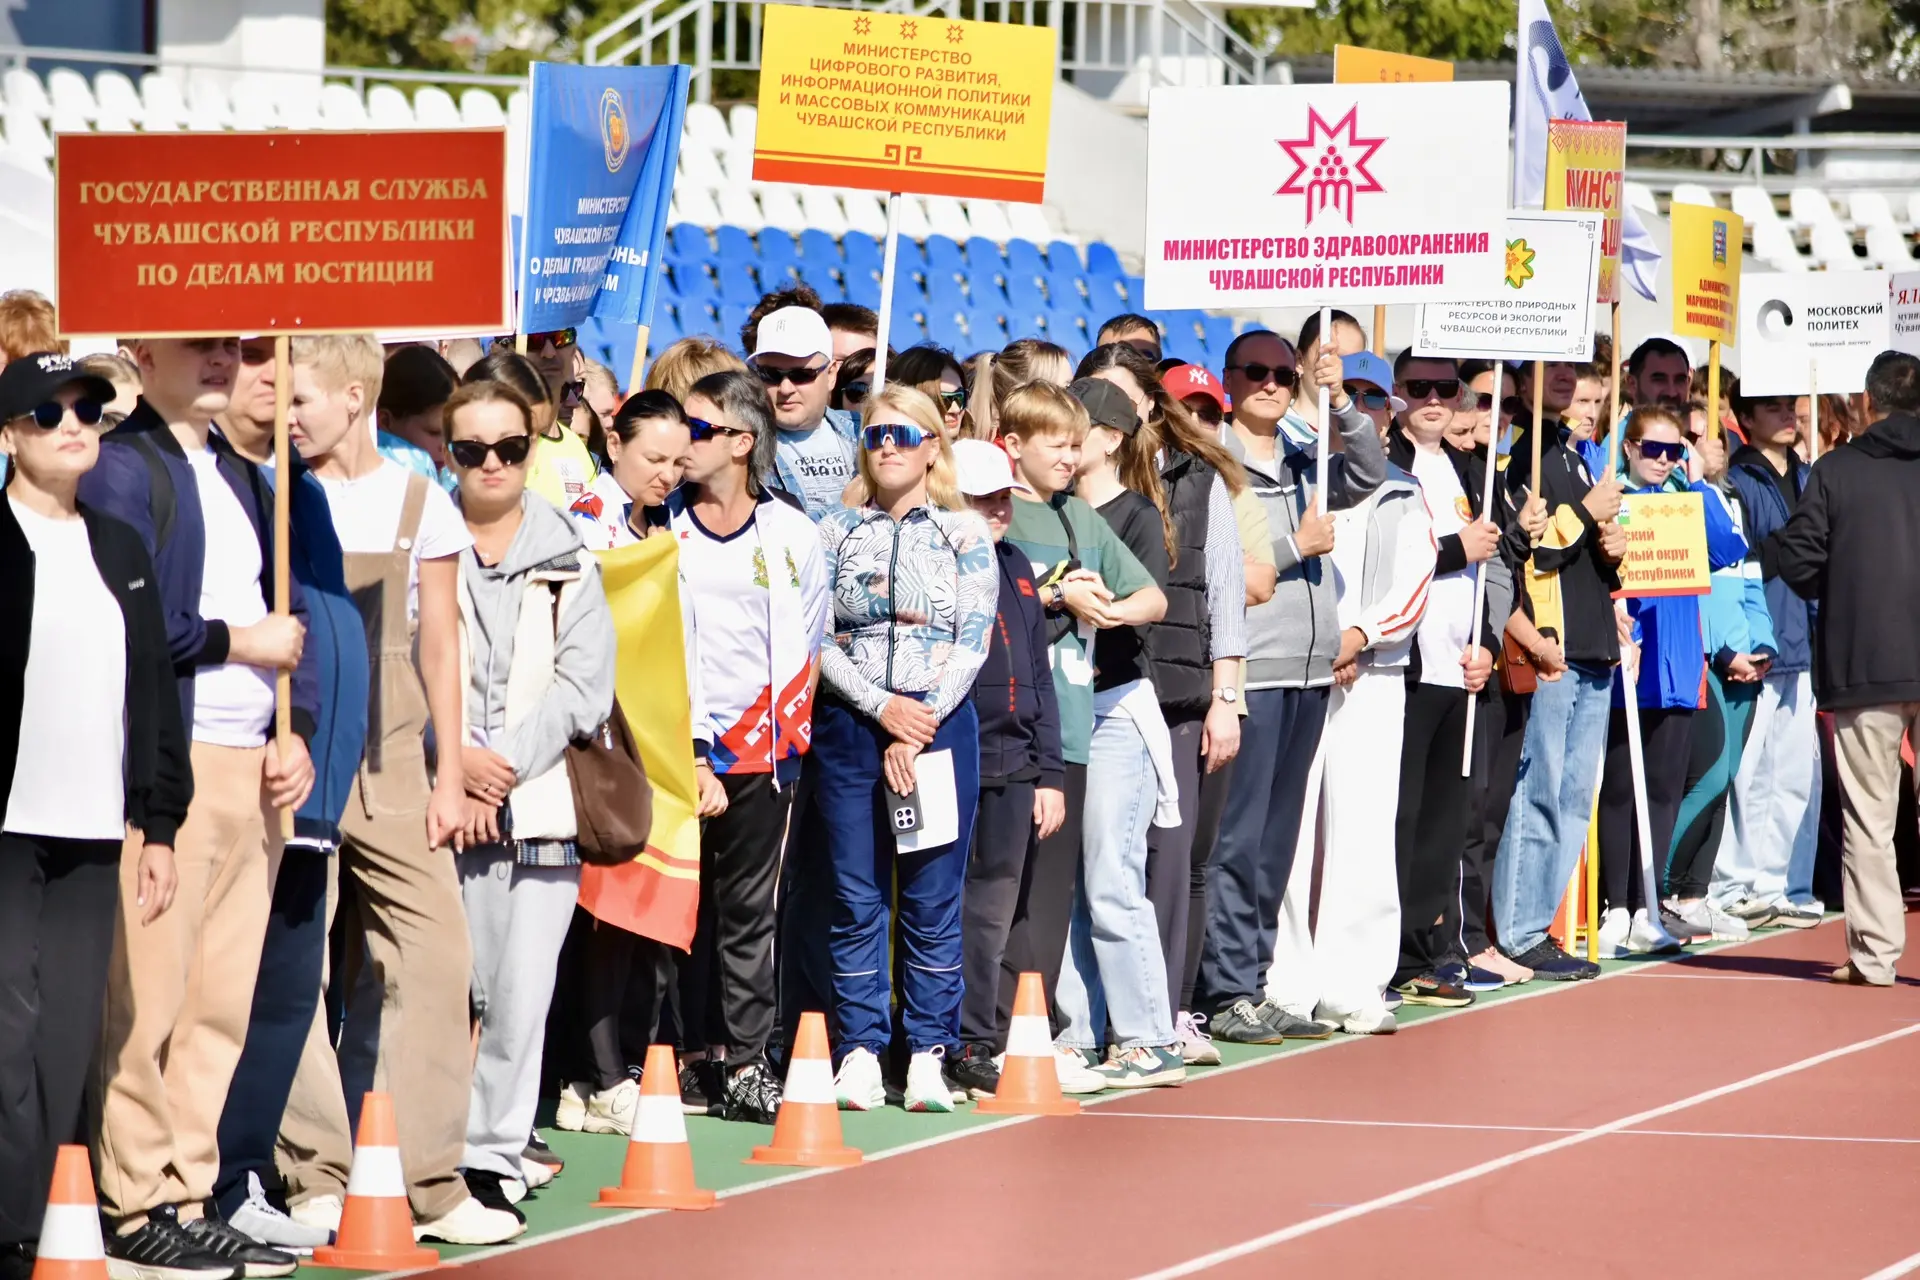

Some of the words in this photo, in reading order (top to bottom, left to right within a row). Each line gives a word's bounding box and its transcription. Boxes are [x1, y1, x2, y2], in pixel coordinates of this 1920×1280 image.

[843, 42, 972, 65] МИНИСТЕРСТВО
[810, 58, 910, 78] ЦИФРОВОГО
[915, 67, 1002, 87] РАЗВИТИЯ,
[781, 74, 942, 99] ИНФОРМАЦИОННОЙ
[947, 88, 1031, 107] ПОЛИТИКИ
[780, 93, 790, 105] И
[795, 93, 889, 114] МАССОВЫХ
[894, 102, 1025, 125] КОММУНИКАЦИЙ
[796, 112, 897, 133] ЧУВАШСКОЙ
[902, 121, 1006, 141] РЕСПУБЛИКИ
[79, 179, 360, 207] ГОСУДАРСТВЕННАЯ
[369, 177, 488, 201] СЛУЖБА
[93, 217, 279, 246] ЧУВАШСКОЙ
[289, 219, 475, 243] РЕСПУБЛИКИ
[554, 224, 601, 244] ЧУВАШСКОЙ
[1163, 237, 1309, 261] МИНИСТЕРСТВО
[1313, 232, 1489, 260] ЗДРАВООХРАНЕНИЯ
[137, 264, 178, 286] ПО
[185, 262, 284, 290] ДЕЛАМ
[294, 260, 434, 286] ЮСТИЦИИ
[1209, 264, 1323, 291] ЧУВАШСКОЙ
[1329, 264, 1444, 288] РЕСПУБЛИКИ
[1448, 311, 1498, 321] РЕСУРСОВ
[1500, 313, 1507, 321] И
[1509, 313, 1561, 323] ЭКОЛОГИИ
[1515, 301, 1576, 311] ПРИРОДНЫХ
[1807, 302, 1883, 317] МОСКОВСКИЙ
[1440, 324, 1502, 334] ЧУВАШСКОЙ
[1503, 326, 1567, 337] РЕСПУБЛИКИ
[1808, 320, 1859, 331] ПОЛИТЕХ
[1656, 548, 1689, 562] округ
